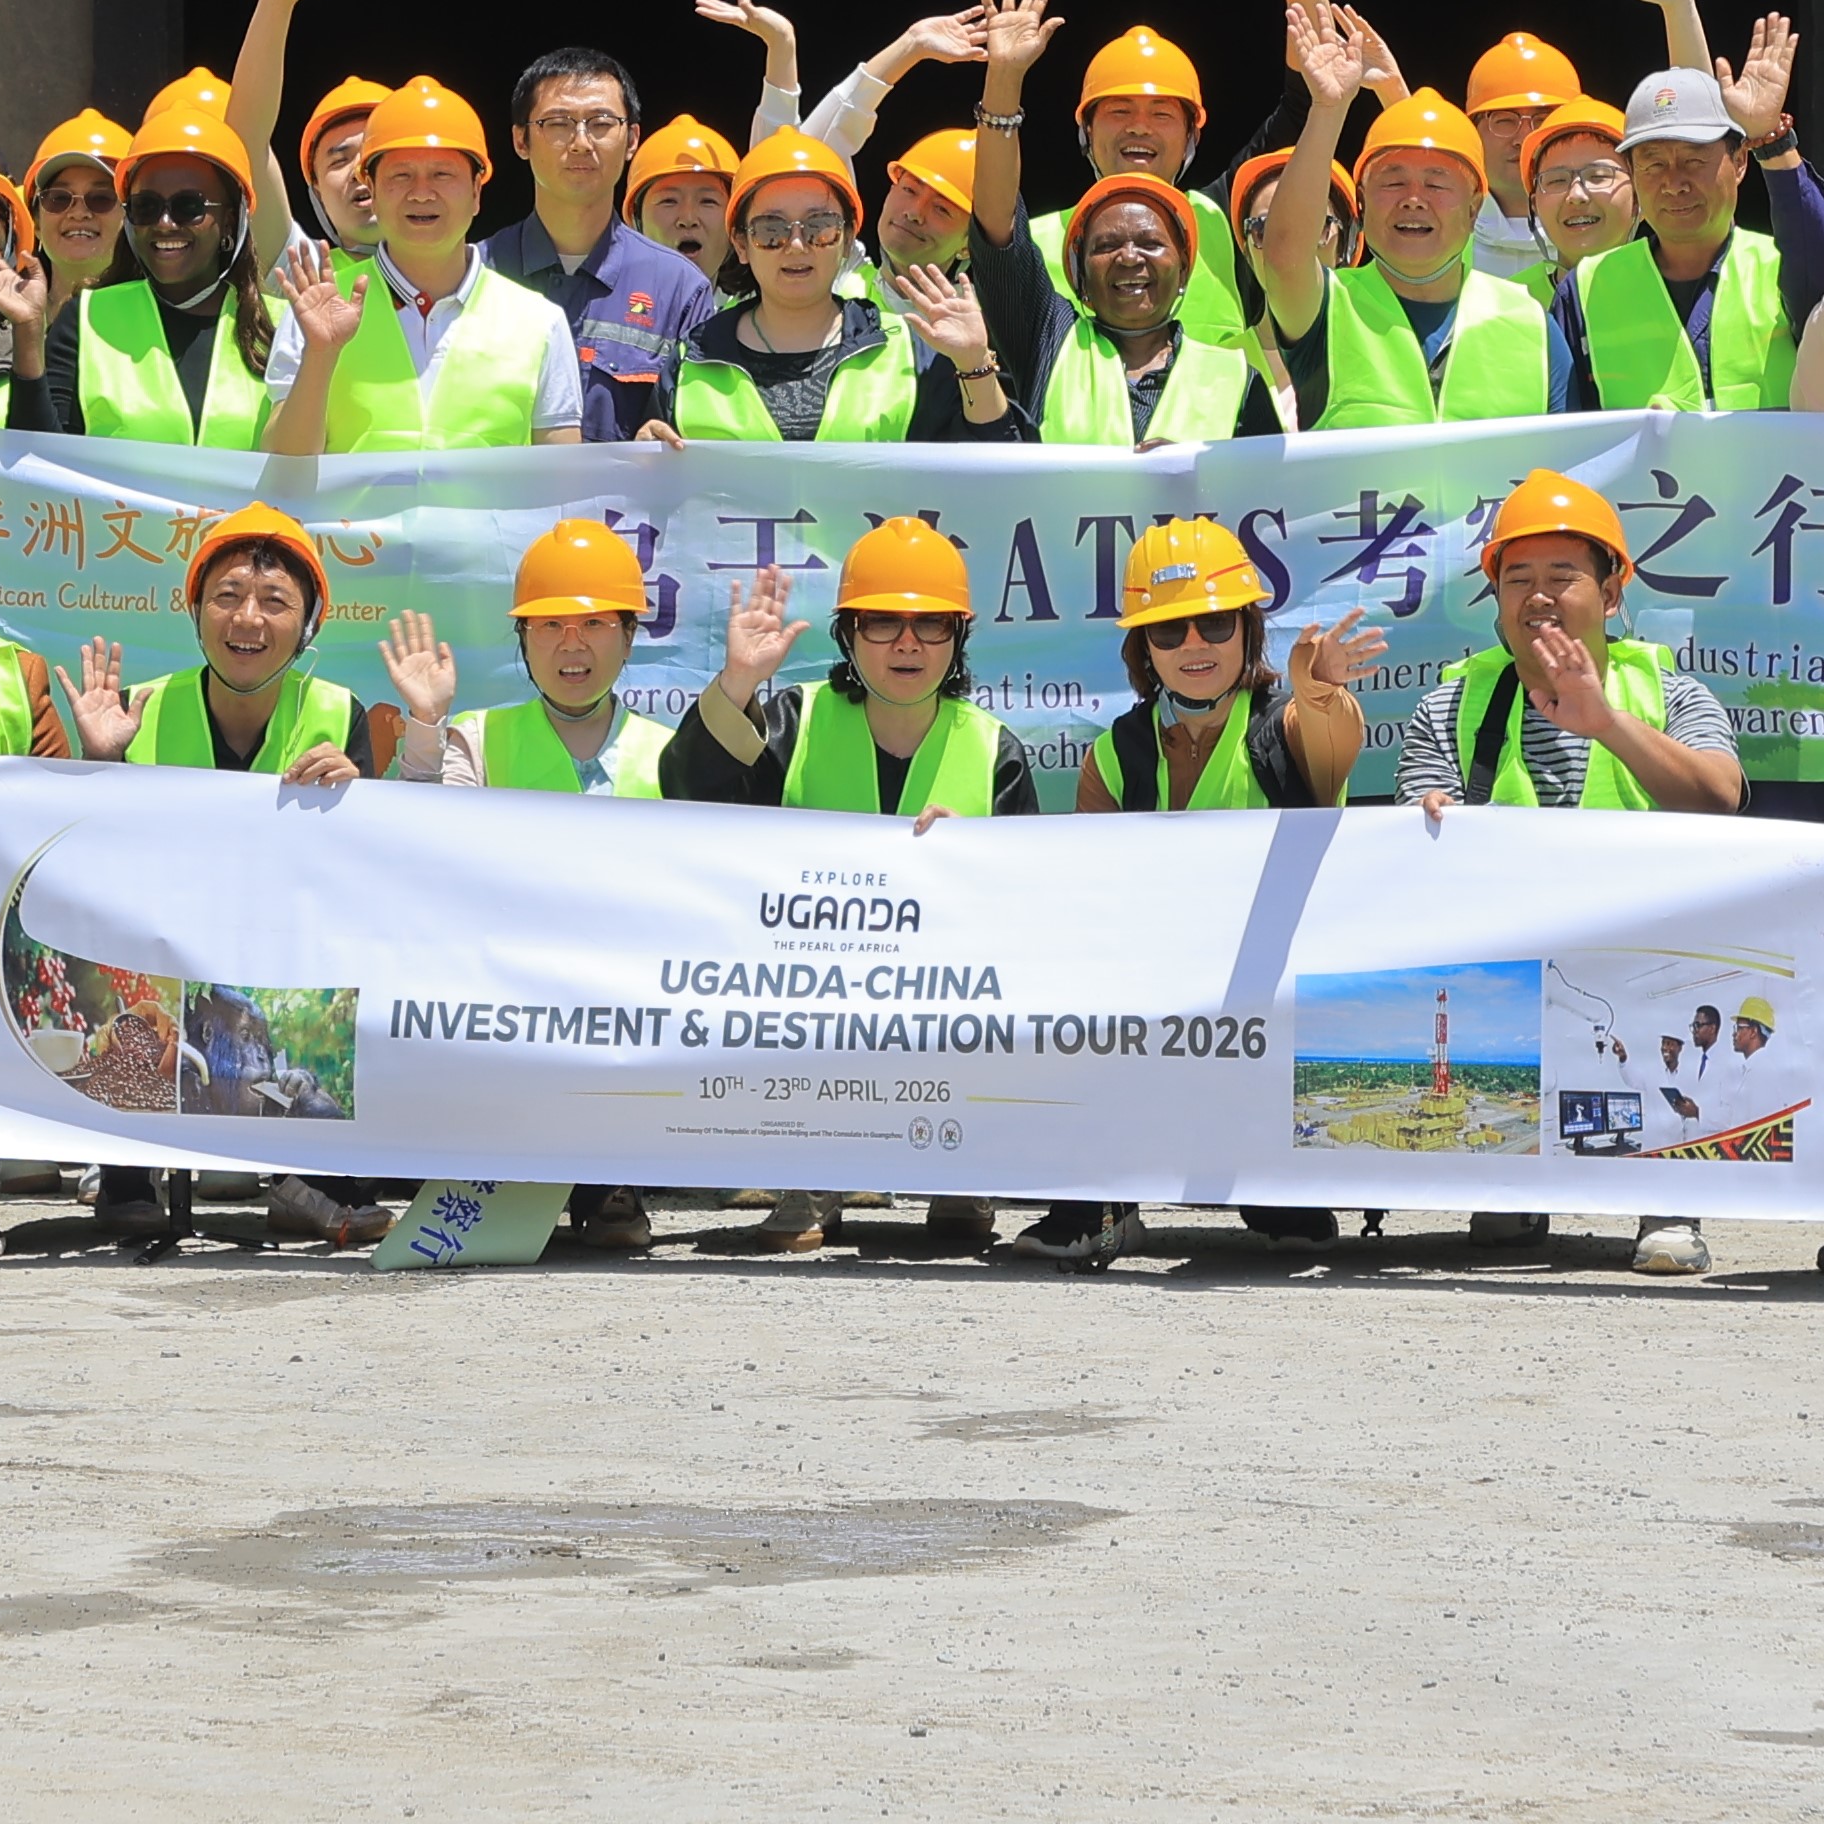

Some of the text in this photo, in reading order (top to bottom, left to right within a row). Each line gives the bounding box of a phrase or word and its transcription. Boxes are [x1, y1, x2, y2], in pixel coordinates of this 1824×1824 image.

[58, 581, 157, 613] Cultural
[169, 587, 187, 613] &
[325, 599, 387, 621] enter
[801, 870, 888, 887] EXPLORE
[759, 892, 921, 933] UGANDA
[773, 940, 900, 953] THE PEARL OF AFRICA
[660, 959, 1003, 1001] UGANDA-CHINA
[389, 999, 1267, 1060] INVESTMENT & DESTINATION TOUR 2026
[699, 1076, 744, 1100] 10TH
[763, 1077, 811, 1101] 23RD
[816, 1079, 888, 1105] APRIL,
[894, 1080, 951, 1103] 2026
